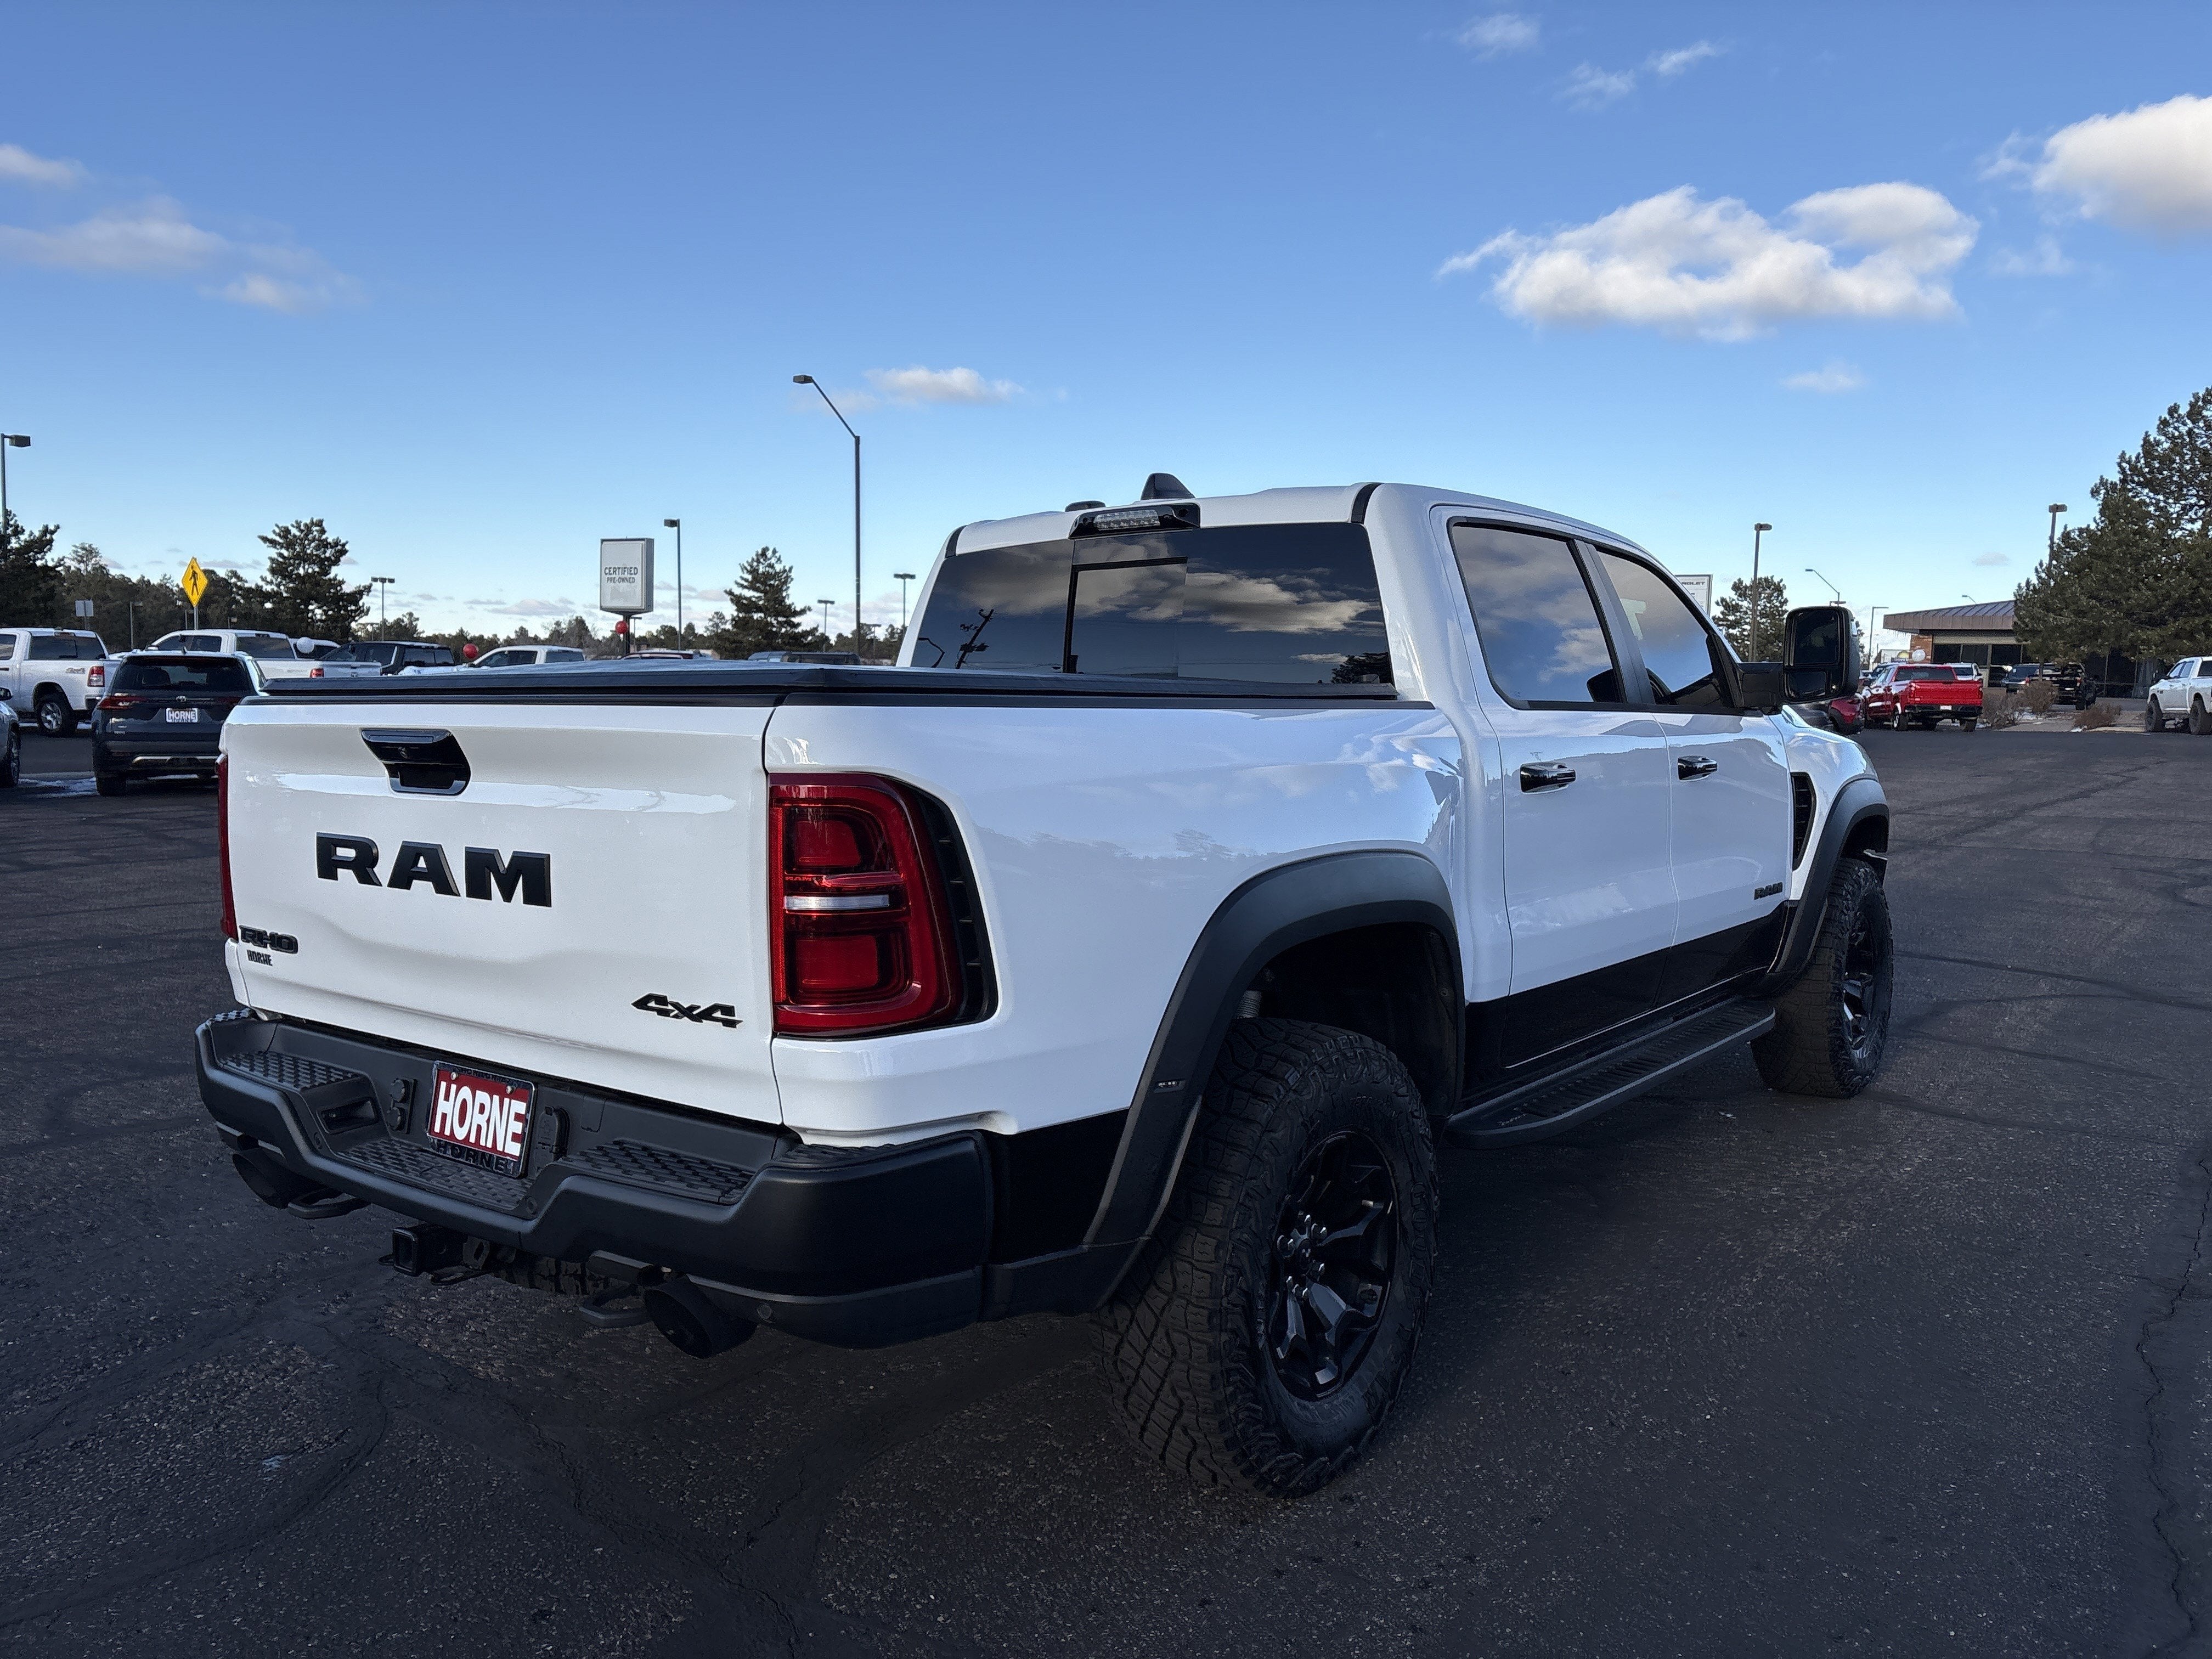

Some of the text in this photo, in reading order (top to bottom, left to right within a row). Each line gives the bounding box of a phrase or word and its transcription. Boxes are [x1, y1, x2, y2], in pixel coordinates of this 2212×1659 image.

[604, 567, 639, 575] CERTIFIED
[168, 710, 195, 720] HORNE
[316, 832, 552, 908] RAM
[1754, 882, 1783, 900] RAM
[247, 949, 273, 967] HORNE
[434, 1081, 527, 1157] HORNE
